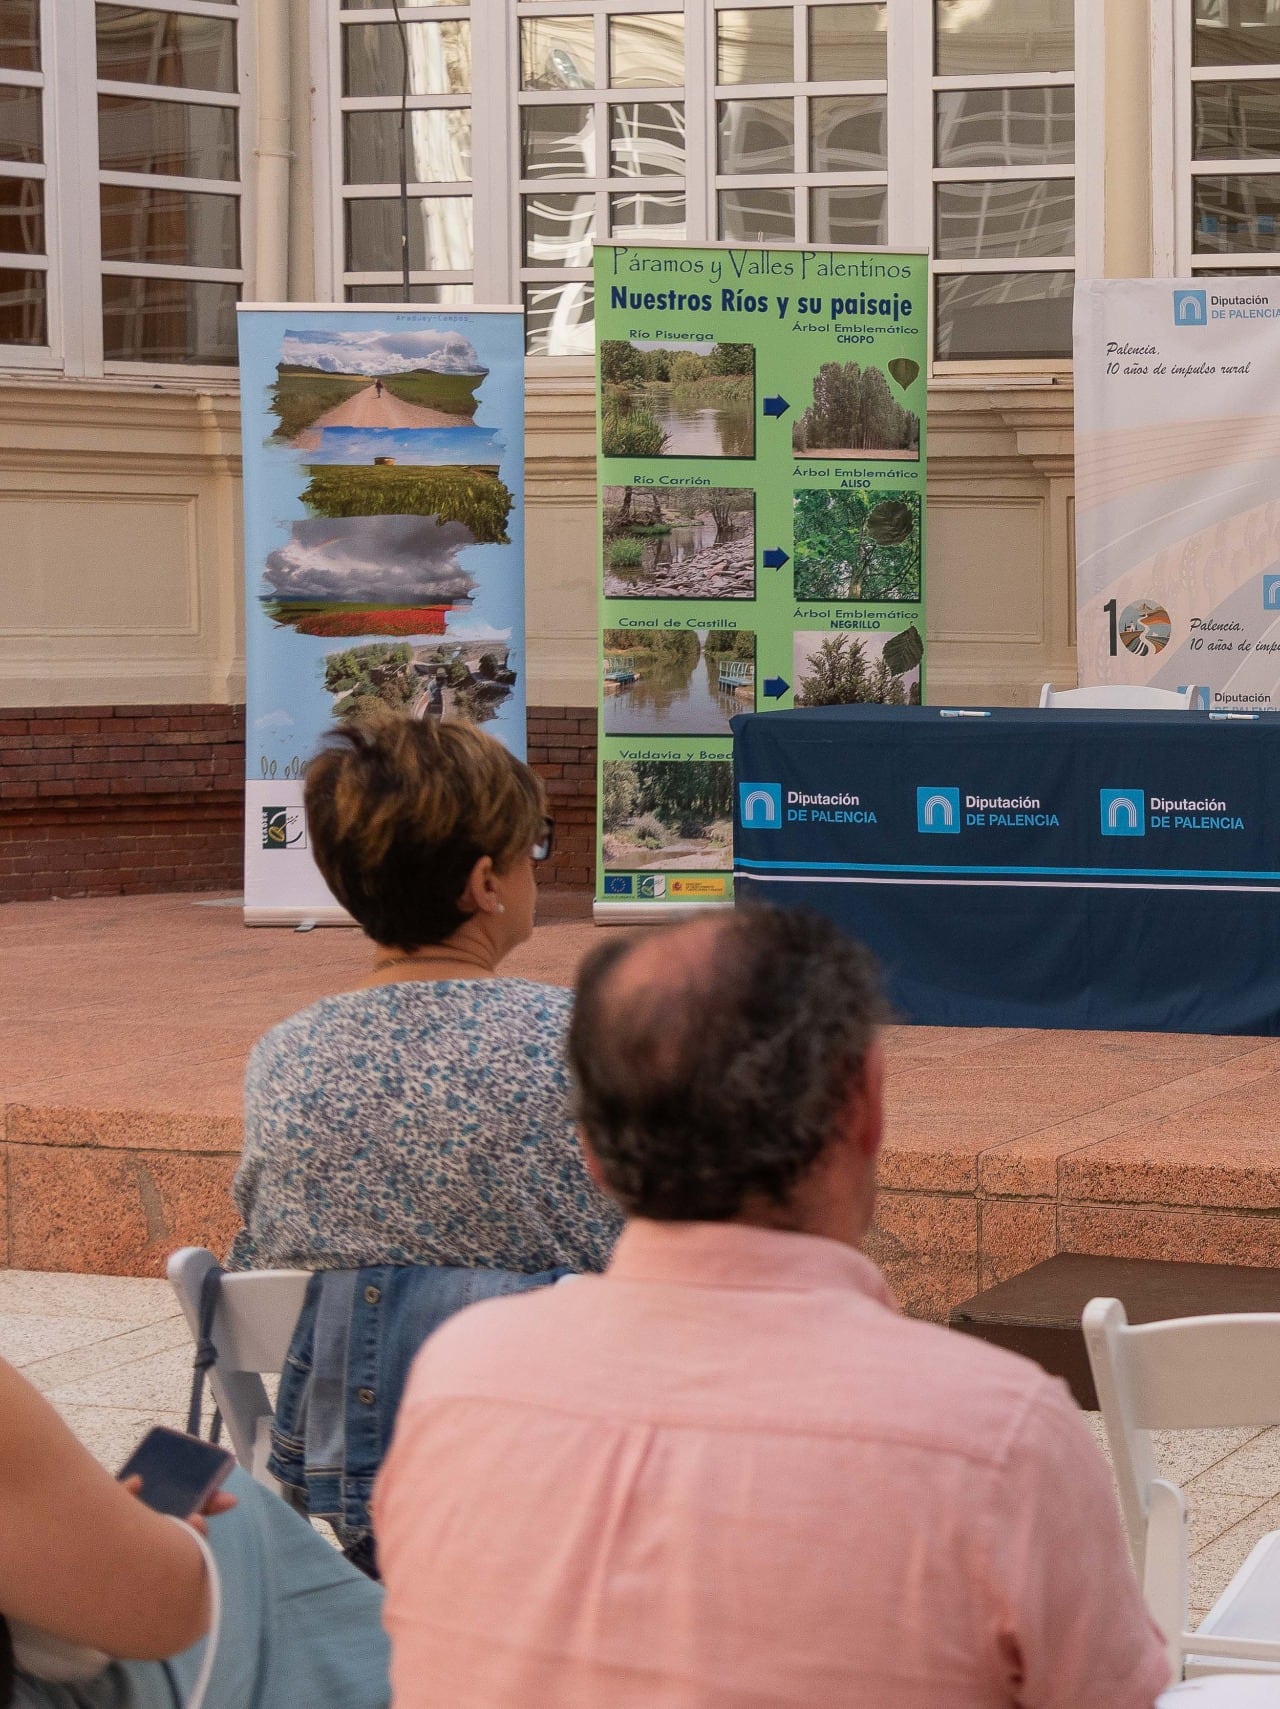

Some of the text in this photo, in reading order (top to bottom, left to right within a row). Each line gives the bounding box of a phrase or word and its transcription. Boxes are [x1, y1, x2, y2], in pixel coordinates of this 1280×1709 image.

[613, 247, 912, 283] Páramos y Valles Palentinos
[611, 286, 912, 321] Nuestros Ríos y su paisaje
[1211, 295, 1269, 307] Diputación
[1211, 310, 1225, 319] DE
[629, 329, 714, 342] Río Pisuerga
[792, 323, 919, 336] Árbol Emblemático
[836, 335, 875, 345] CHOPO
[1106, 361, 1252, 378] 10 años de impulso rural
[793, 466, 919, 479] Árbol Emblemático
[633, 475, 711, 487] Río Carrión
[840, 479, 871, 489] ALISO
[793, 606, 919, 620] Árbol Emblemático
[618, 617, 737, 628] Canal de Castilla
[830, 620, 881, 630] NEGRILLO
[1190, 637, 1204, 651] 10
[1207, 638, 1233, 652] años
[1237, 638, 1251, 652] de
[1214, 692, 1271, 704] Diputación
[619, 750, 681, 760] Valdavia
[687, 752, 694, 762] y
[787, 791, 860, 807] Diputación
[966, 795, 1041, 811] Diputación
[1151, 797, 1227, 813] Diputación
[787, 809, 878, 825] DE PALENCIA
[966, 813, 1060, 827] DE PALENCIA
[1150, 816, 1245, 830] DE PALENCIA
